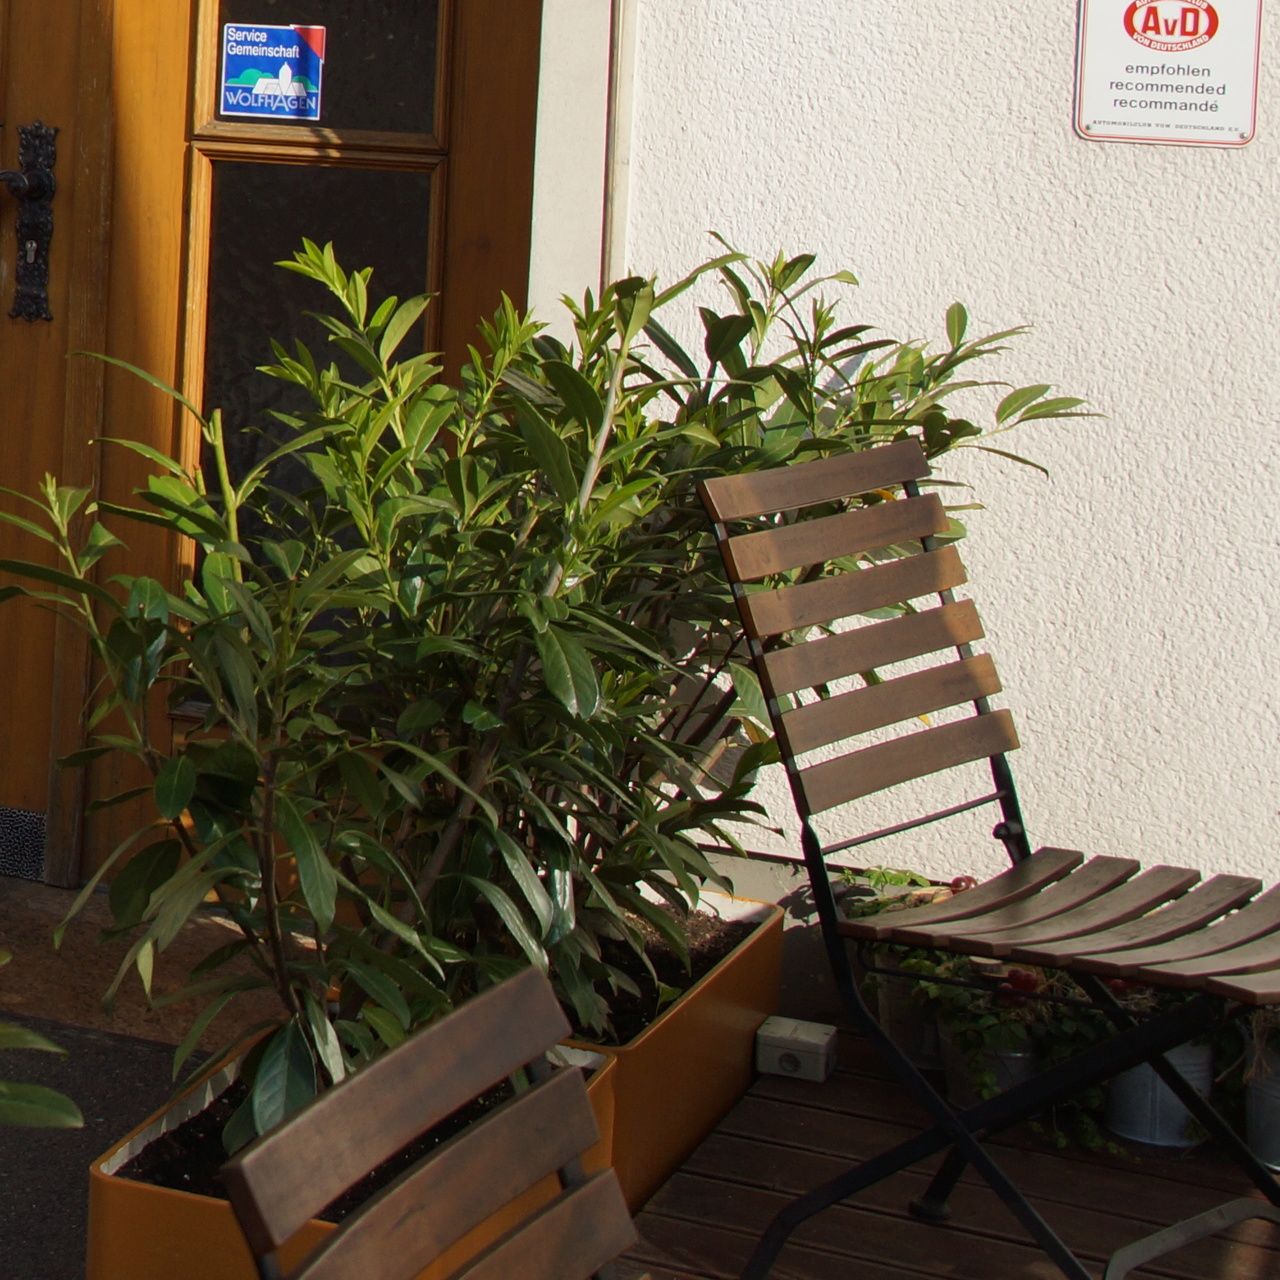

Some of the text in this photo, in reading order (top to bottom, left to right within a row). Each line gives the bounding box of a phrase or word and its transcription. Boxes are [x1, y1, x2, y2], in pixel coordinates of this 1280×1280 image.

[1141, 6, 1200, 37] AvD
[227, 27, 268, 42] Service
[1150, 34, 1209, 51] DEUTSCHLAND
[227, 42, 300, 58] Gemeinschaft
[1125, 63, 1211, 77] empfohlen
[1109, 80, 1227, 96] recommended
[225, 89, 316, 112] WOLFHAGEN
[1113, 98, 1219, 113] recommandé
